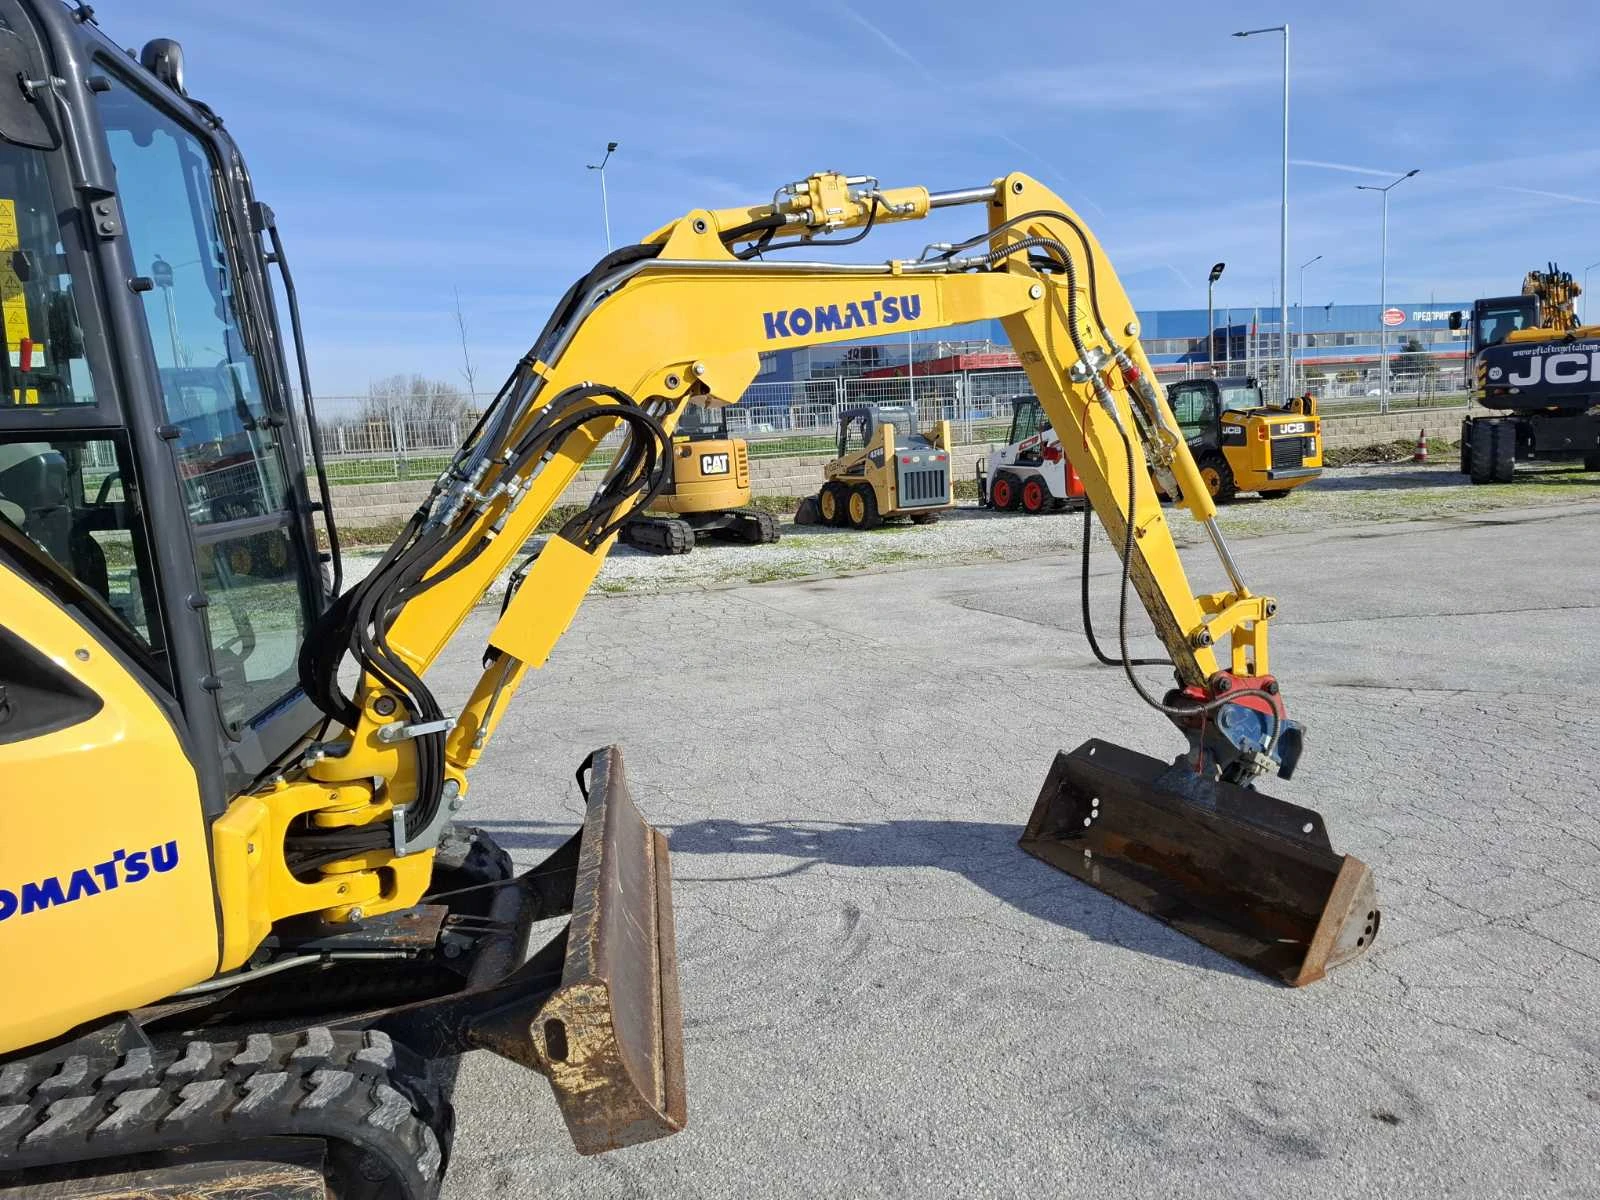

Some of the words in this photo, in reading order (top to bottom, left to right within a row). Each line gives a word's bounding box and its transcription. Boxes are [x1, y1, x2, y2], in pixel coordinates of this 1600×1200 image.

[763, 290, 922, 340] KOMATSU
[1508, 352, 1600, 386] JC
[1222, 426, 1242, 434] JCB
[1280, 422, 1305, 434] JCB
[702, 454, 728, 474] CAT
